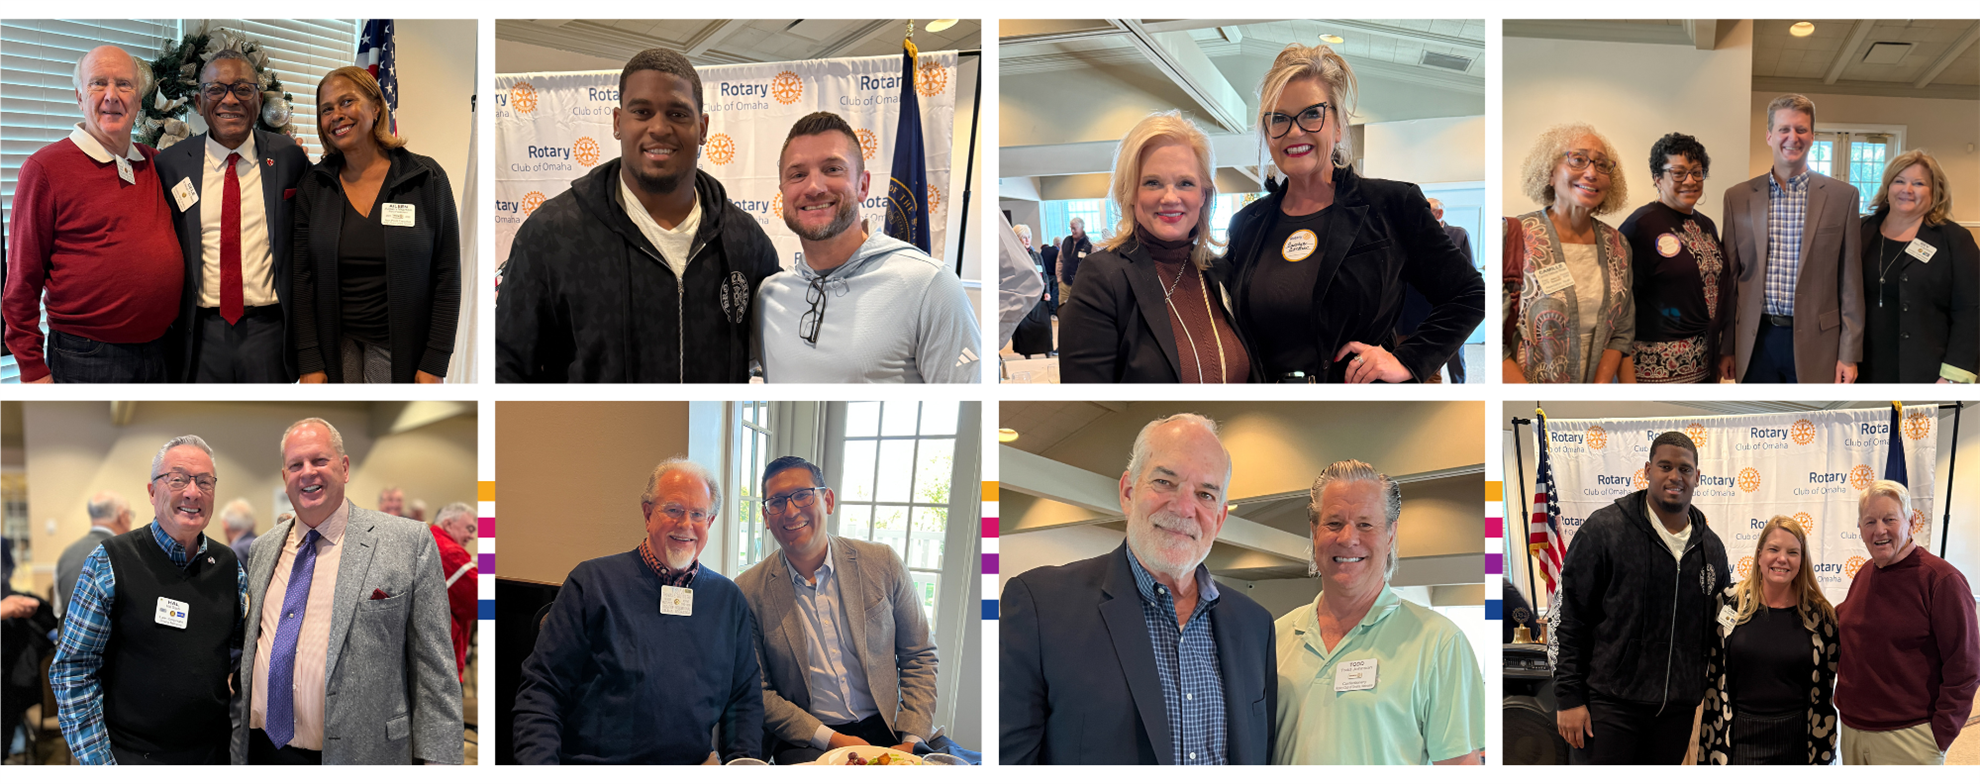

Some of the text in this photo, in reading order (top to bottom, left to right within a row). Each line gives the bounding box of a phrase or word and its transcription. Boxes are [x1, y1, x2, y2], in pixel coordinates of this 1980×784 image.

[860, 75, 902, 90] Rotar
[588, 87, 620, 101] Rota
[720, 82, 768, 98] Rotary
[839, 94, 901, 106] Club of Oma
[572, 106, 591, 116] Club
[593, 106, 602, 115] of
[702, 100, 769, 113] Club of Omaha
[528, 145, 570, 160] Rotary
[511, 162, 572, 172] Club of Omaha
[495, 199, 519, 214] tary
[727, 198, 769, 214] otary
[495, 215, 521, 224] Omaha
[1750, 427, 1788, 440] Rotary
[1861, 423, 1889, 435] Rota
[1551, 431, 1584, 444] Rotary
[1844, 438, 1862, 447] Club
[1863, 438, 1872, 447] of
[1562, 445, 1585, 454] Omaha
[1634, 444, 1649, 452] Club
[1735, 442, 1788, 451] Club of Omaha
[1597, 474, 1632, 487] Rotary
[1700, 474, 1736, 488] Rotary
[1809, 471, 1848, 485] Rotary
[1583, 488, 1600, 496] Club
[1600, 488, 1608, 496] of
[1692, 489, 1736, 497] ub of Omaha
[1793, 486, 1847, 496] Club of Omaha
[1735, 532, 1751, 540] Club
[1840, 531, 1857, 539] Club
[1813, 562, 1843, 574] otary
[1817, 575, 1842, 583] Omaha
